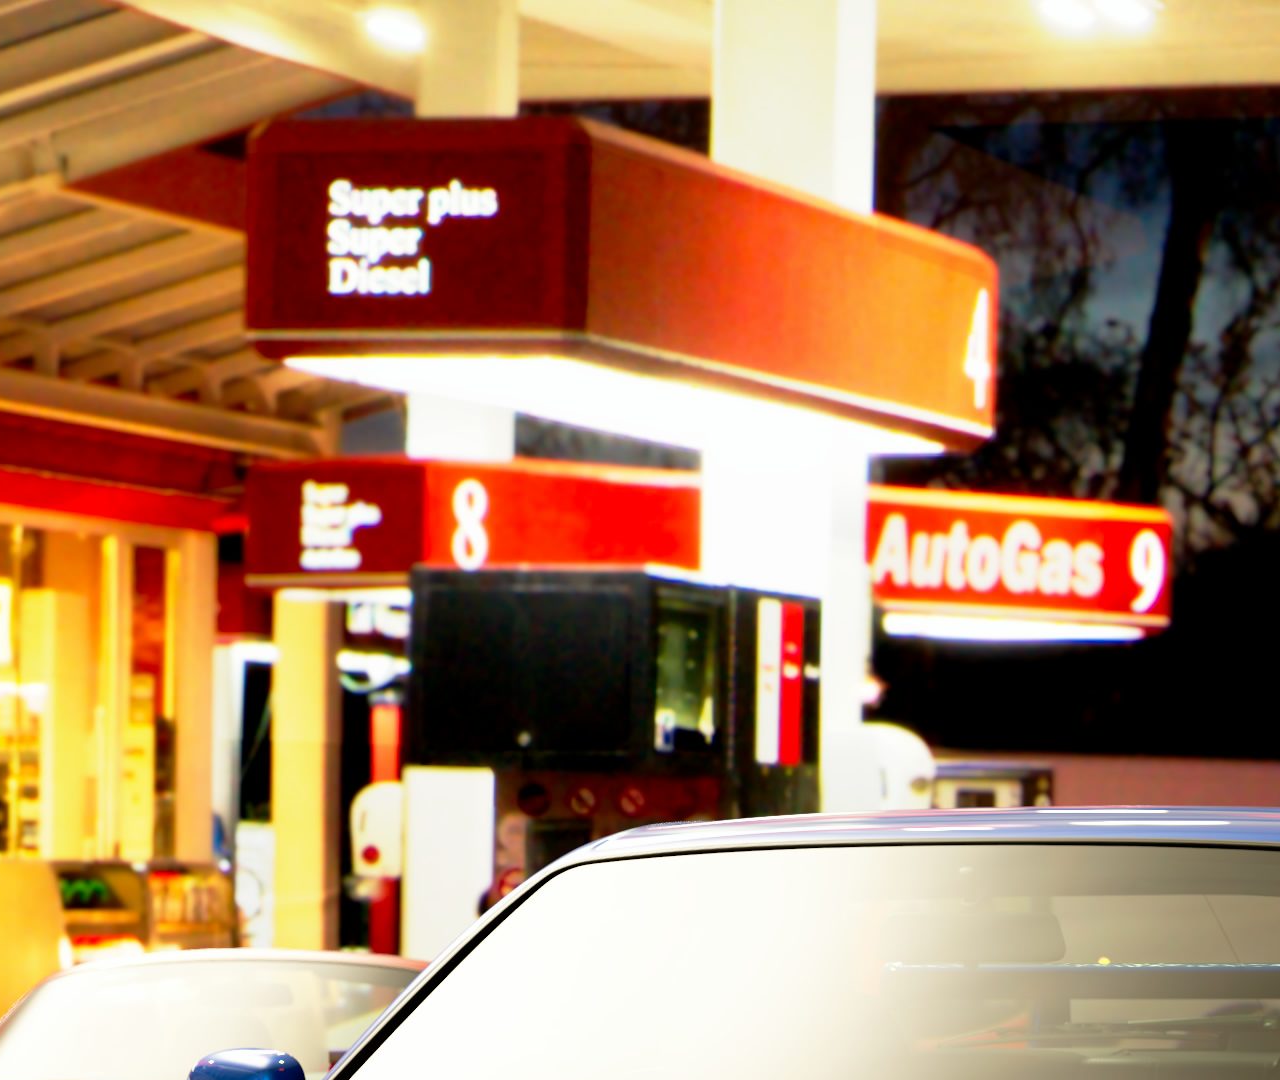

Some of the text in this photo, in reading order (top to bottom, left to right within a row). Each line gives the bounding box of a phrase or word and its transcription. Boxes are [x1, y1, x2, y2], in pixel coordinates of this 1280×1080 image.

[427, 178, 498, 225] plus
[328, 257, 432, 294] Diesel
[964, 287, 991, 409] 4
[452, 478, 489, 572] 8
[871, 513, 1165, 613] AutoGas 9
